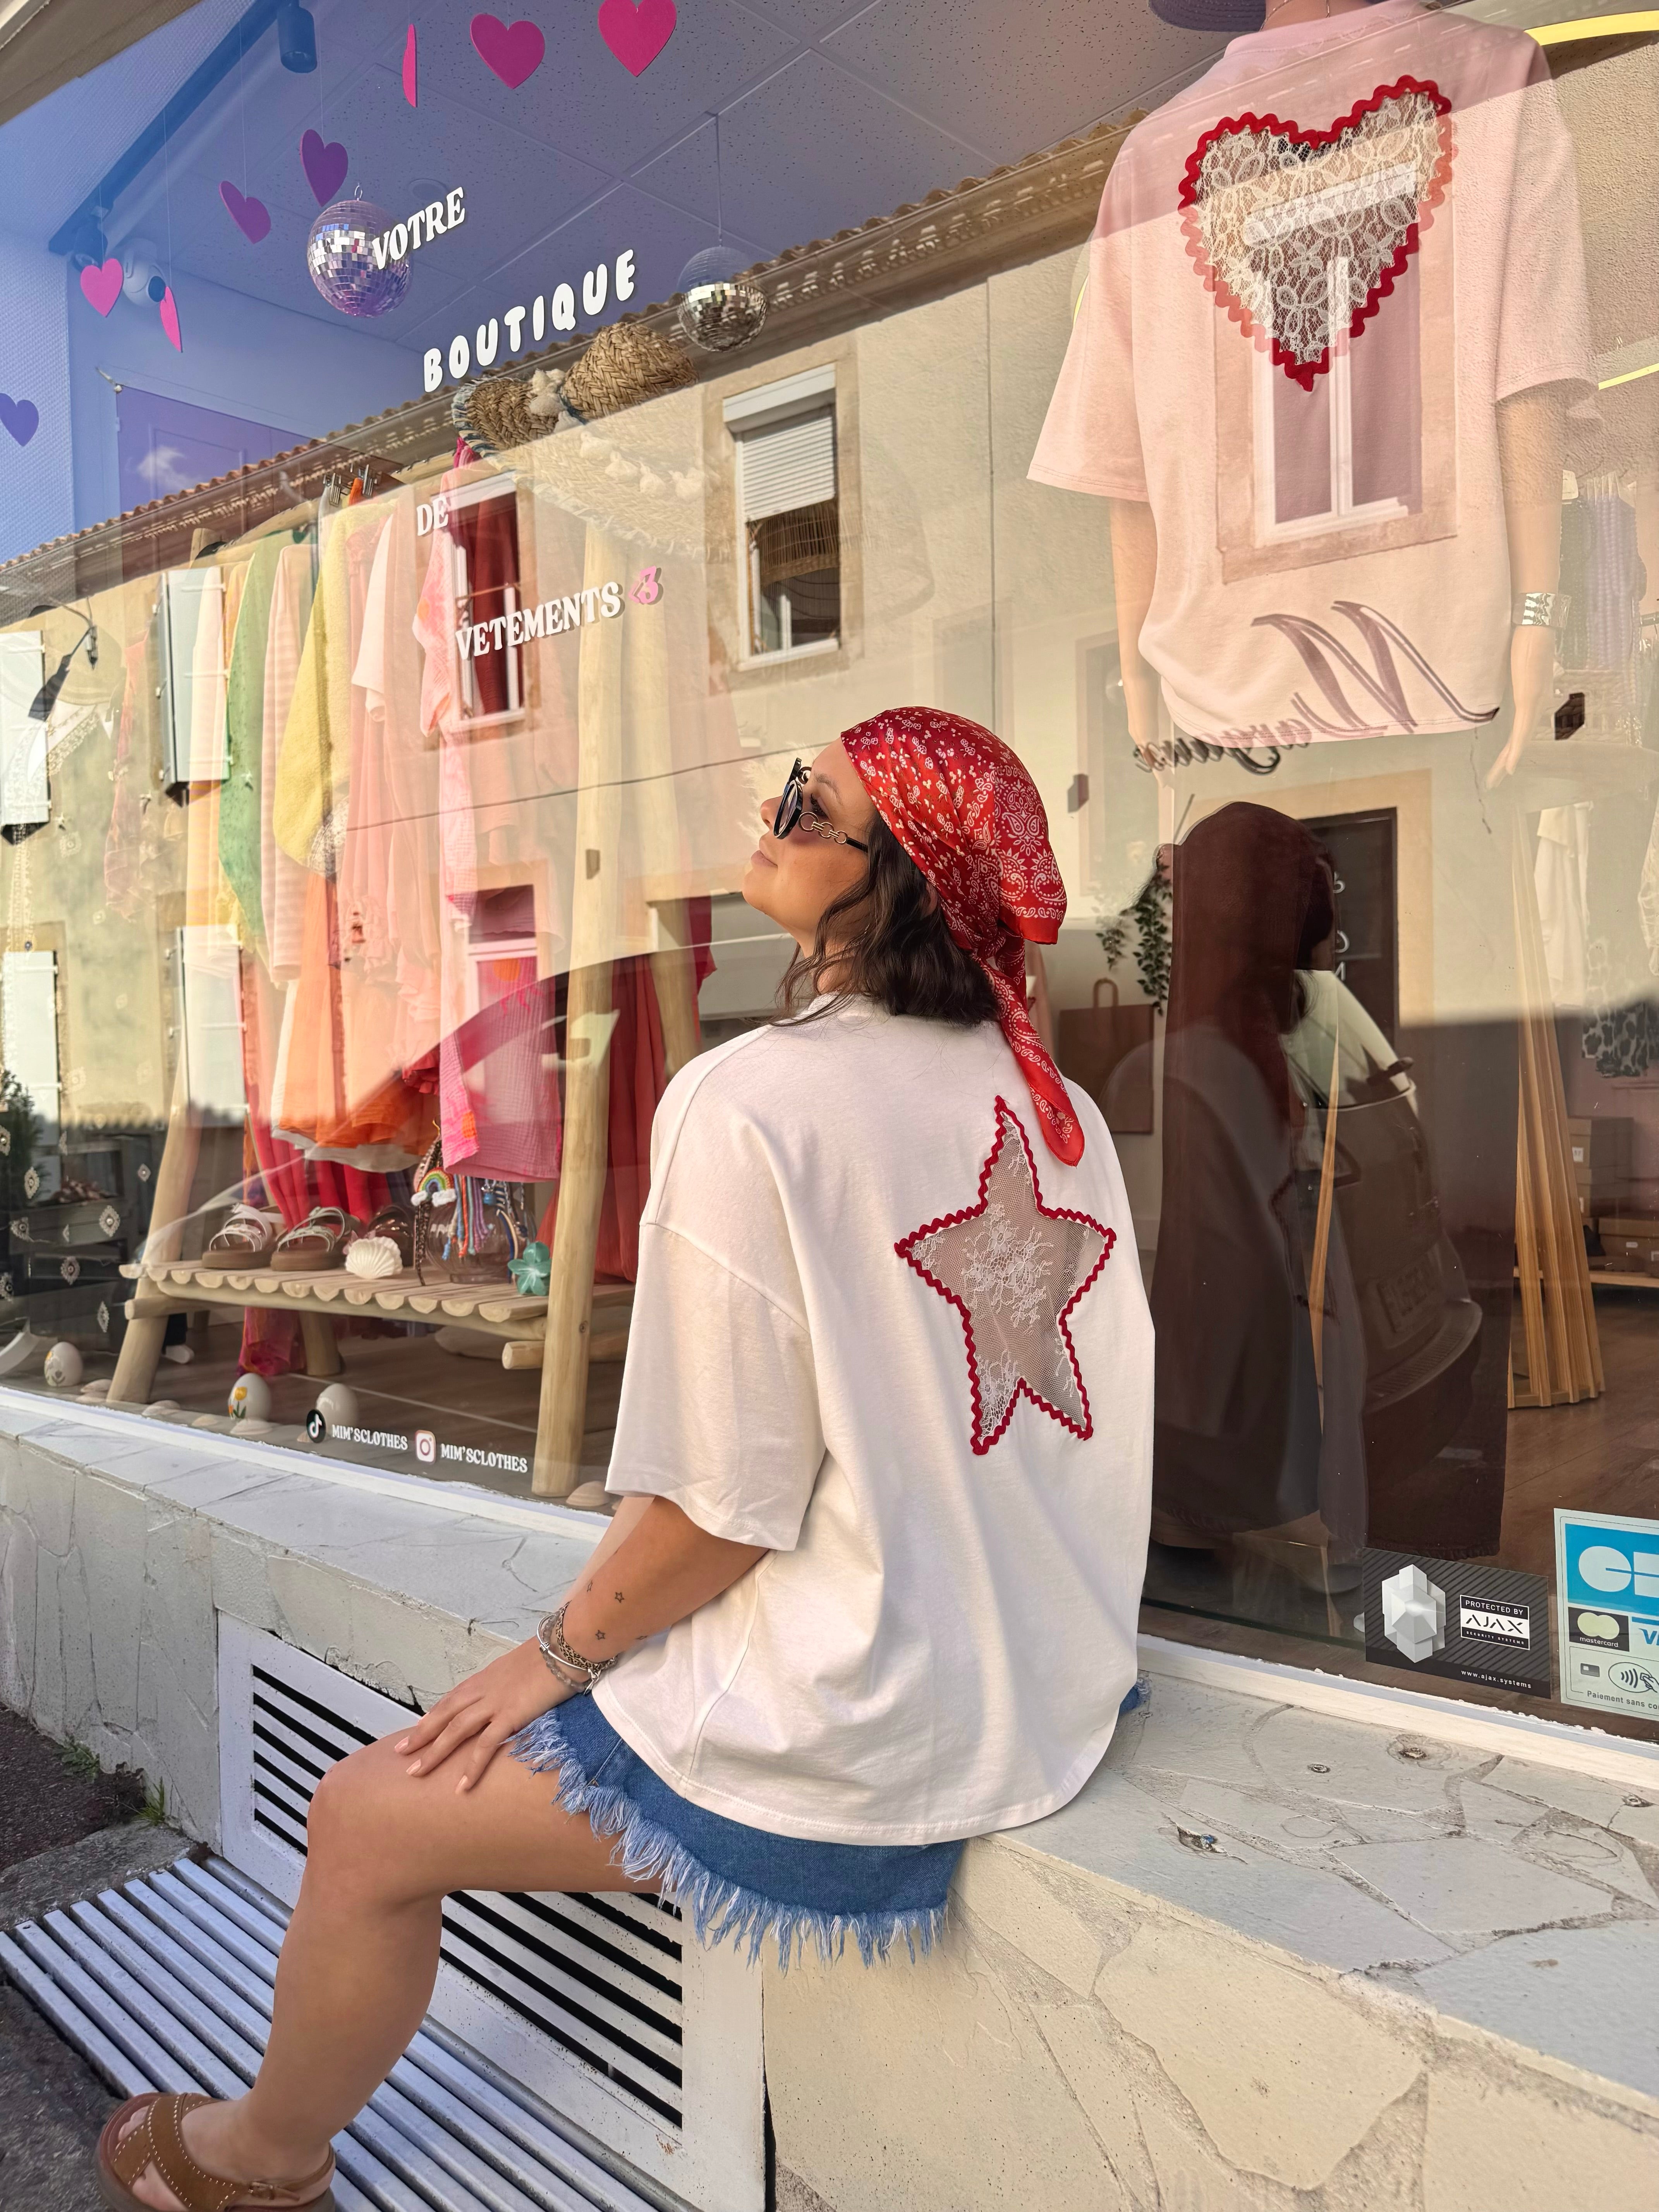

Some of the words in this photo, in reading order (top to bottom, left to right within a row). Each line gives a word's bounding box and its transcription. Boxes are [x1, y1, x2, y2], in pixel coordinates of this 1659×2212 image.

[372, 187, 465, 270] VOTRE
[424, 249, 635, 392] BOUTIQUE
[417, 496, 449, 536] DE
[455, 582, 621, 660] VETEMENTS
[332, 1424, 408, 1450] MIM'SCLOTHES
[441, 1443, 528, 1473] MIM'SCLOTHES
[1465, 1600, 1510, 1613] PROTECTED
[1466, 1614, 1524, 1634] AJAX
[1498, 1637, 1525, 1645] SYSTEMS
[1580, 1637, 1619, 1647] mastercard
[1461, 1670, 1532, 1689] www.ajax.systems
[1587, 1690, 1624, 1704] Paiement
[1626, 1699, 1645, 1707] sans
